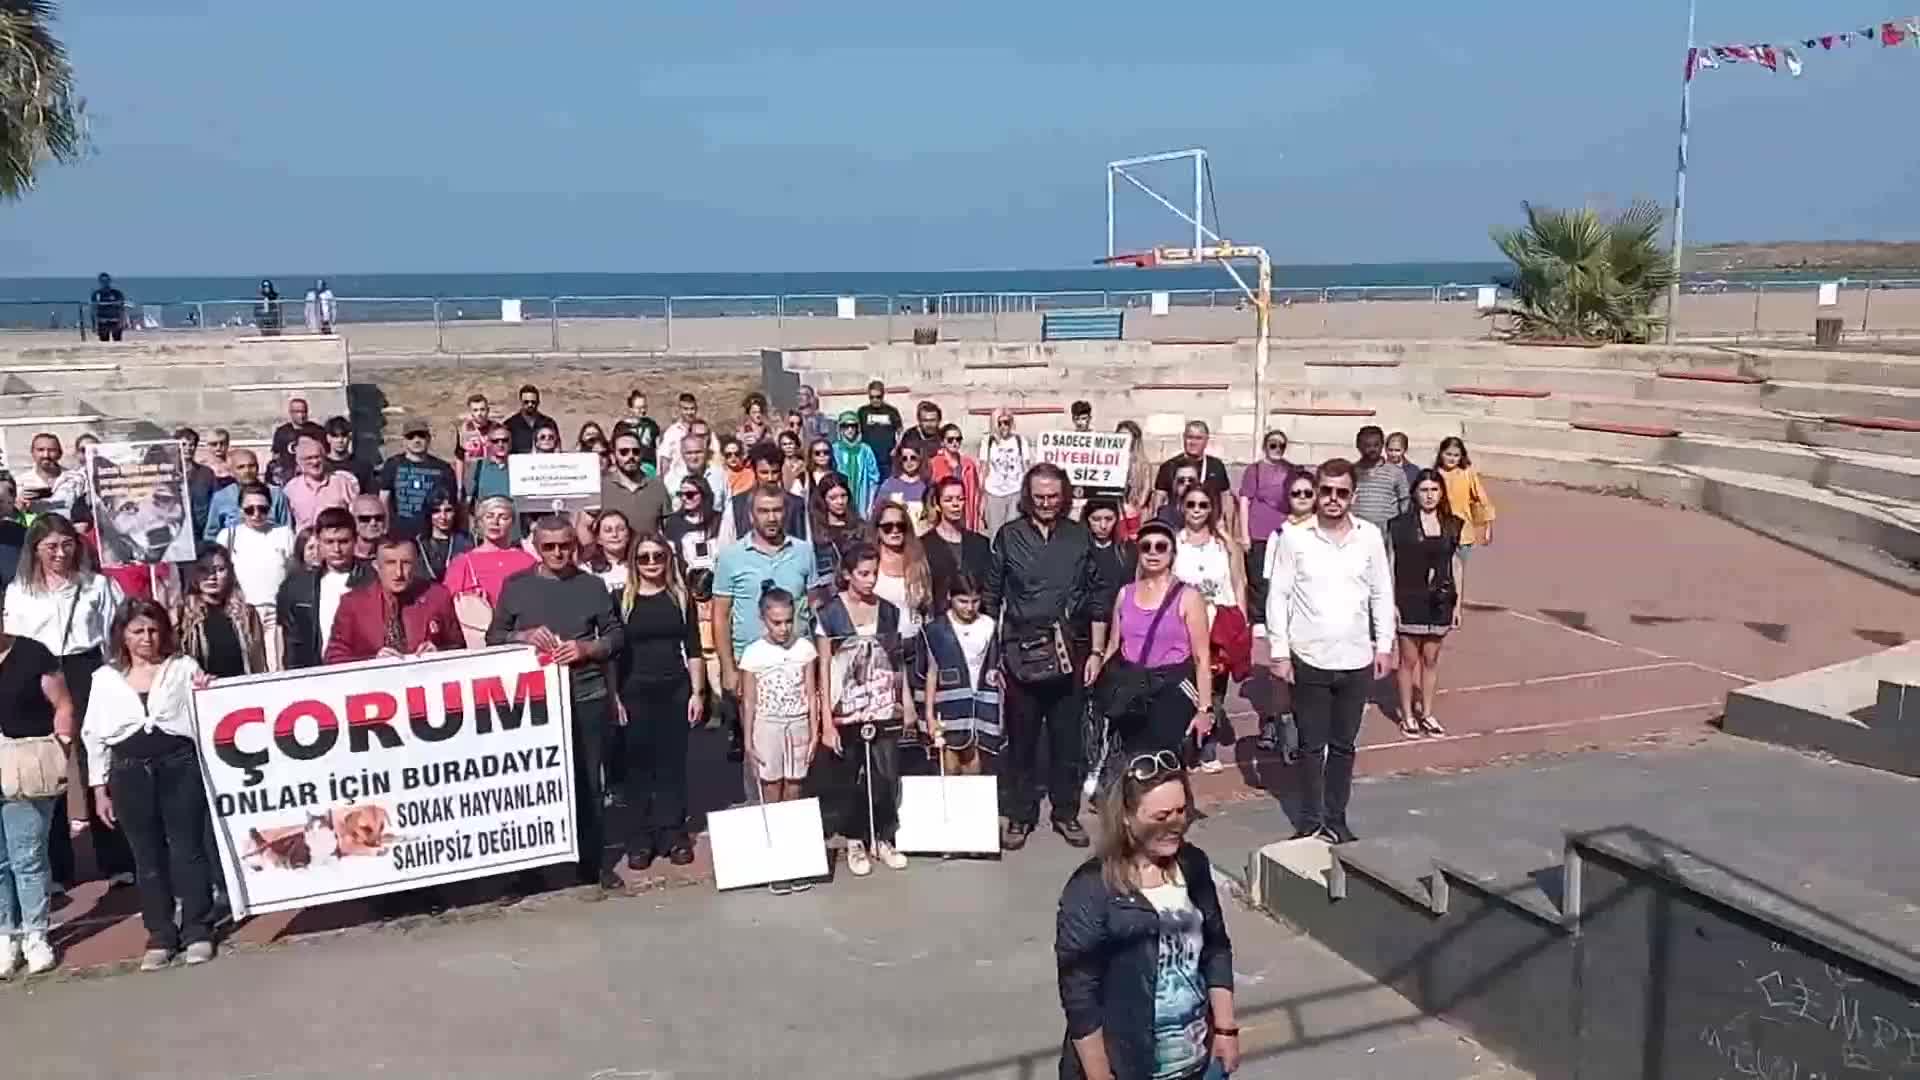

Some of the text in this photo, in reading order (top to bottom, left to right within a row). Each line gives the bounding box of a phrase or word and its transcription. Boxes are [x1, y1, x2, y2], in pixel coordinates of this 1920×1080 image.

[1042, 433, 1050, 447] O
[1052, 434, 1093, 449] SADECE
[1044, 448, 1120, 466] DİYEBİLDİ
[1073, 467, 1111, 481] SİZ ?
[213, 670, 549, 787] ÇORUM
[215, 745, 561, 818] ONLAR İÇİN BURADAYIZ
[396, 778, 563, 828] SOKAK HAYVANLARI
[393, 815, 567, 871] SAHİPSİZ DEĞİLDİR !
